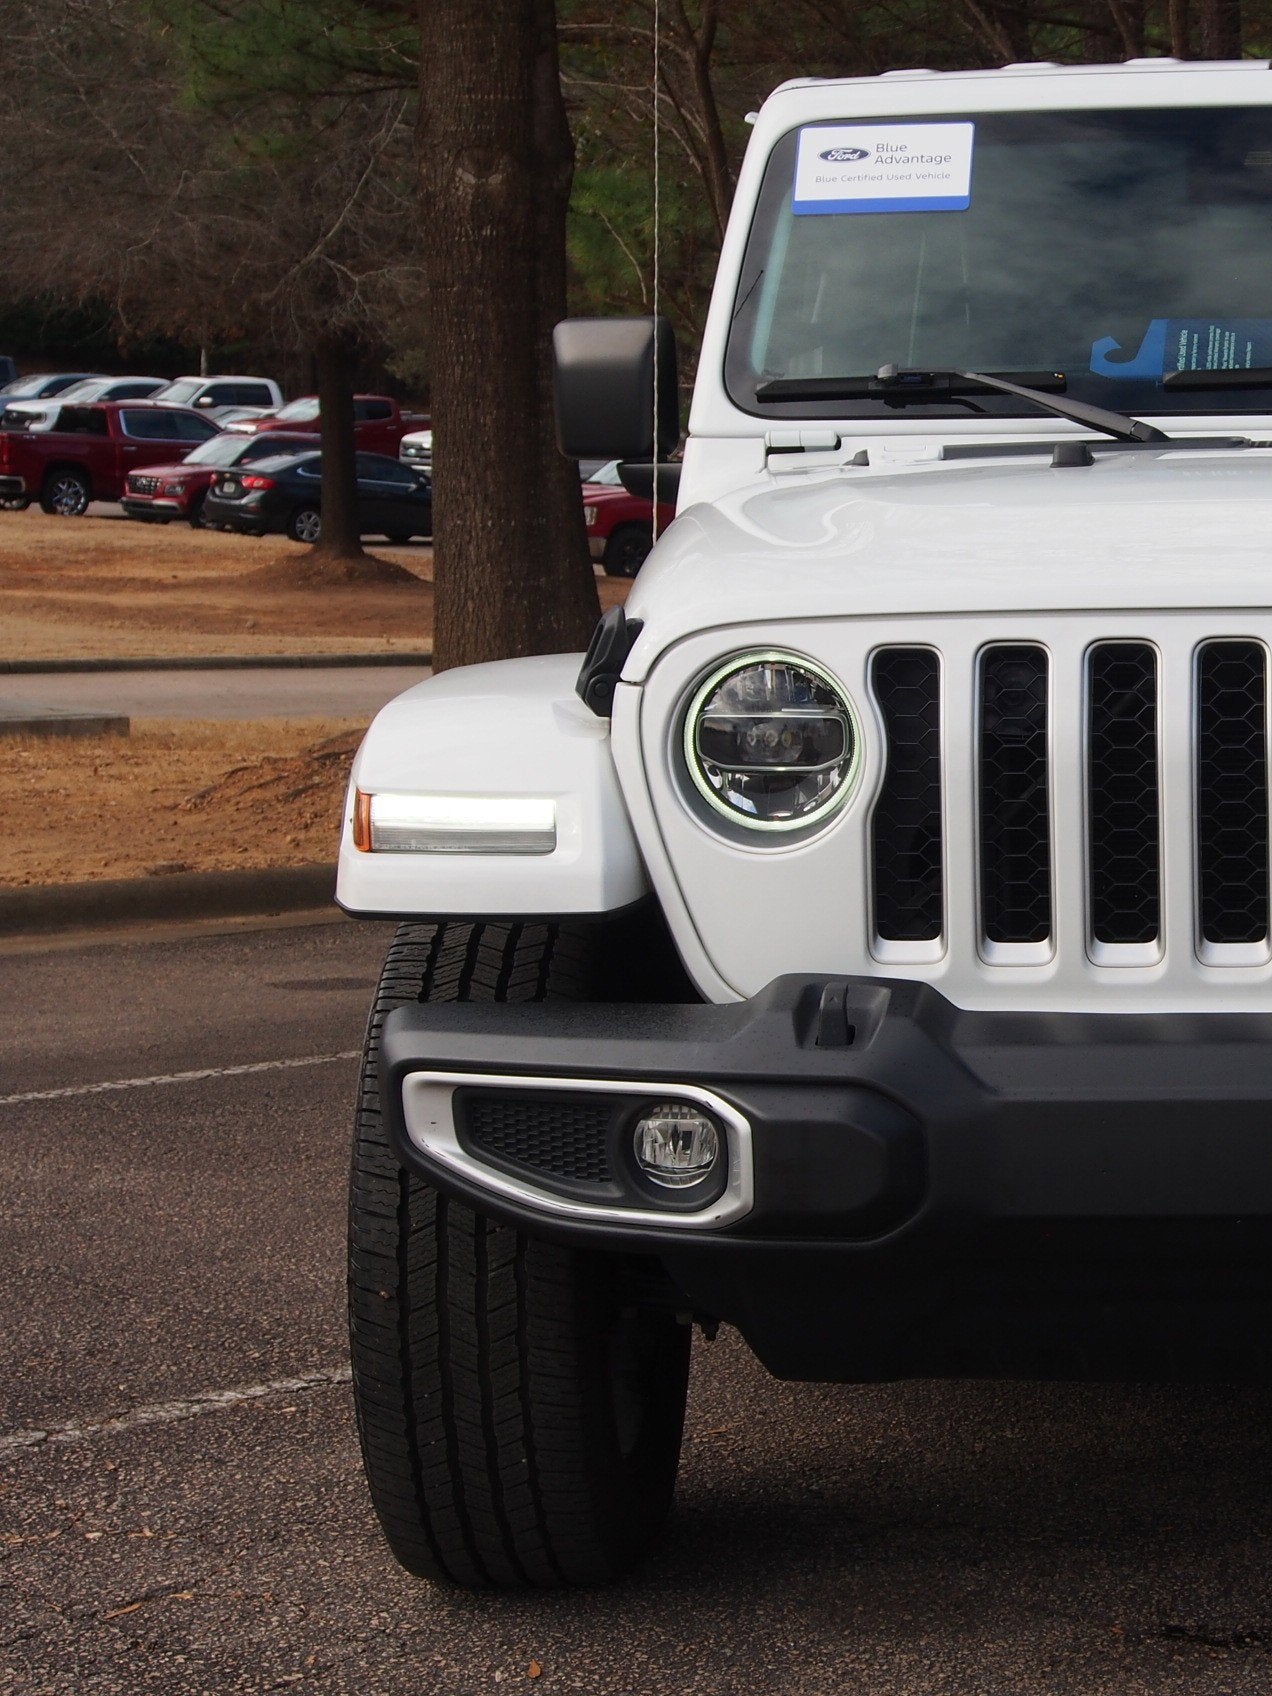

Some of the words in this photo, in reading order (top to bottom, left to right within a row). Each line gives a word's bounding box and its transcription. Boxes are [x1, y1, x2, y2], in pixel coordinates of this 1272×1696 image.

[875, 142, 908, 153] Blue
[874, 154, 952, 165] Advantage
[815, 175, 838, 183] Blue
[840, 173, 883, 182] Certified
[886, 172, 912, 181] Used
[915, 171, 951, 180] Vehicle
